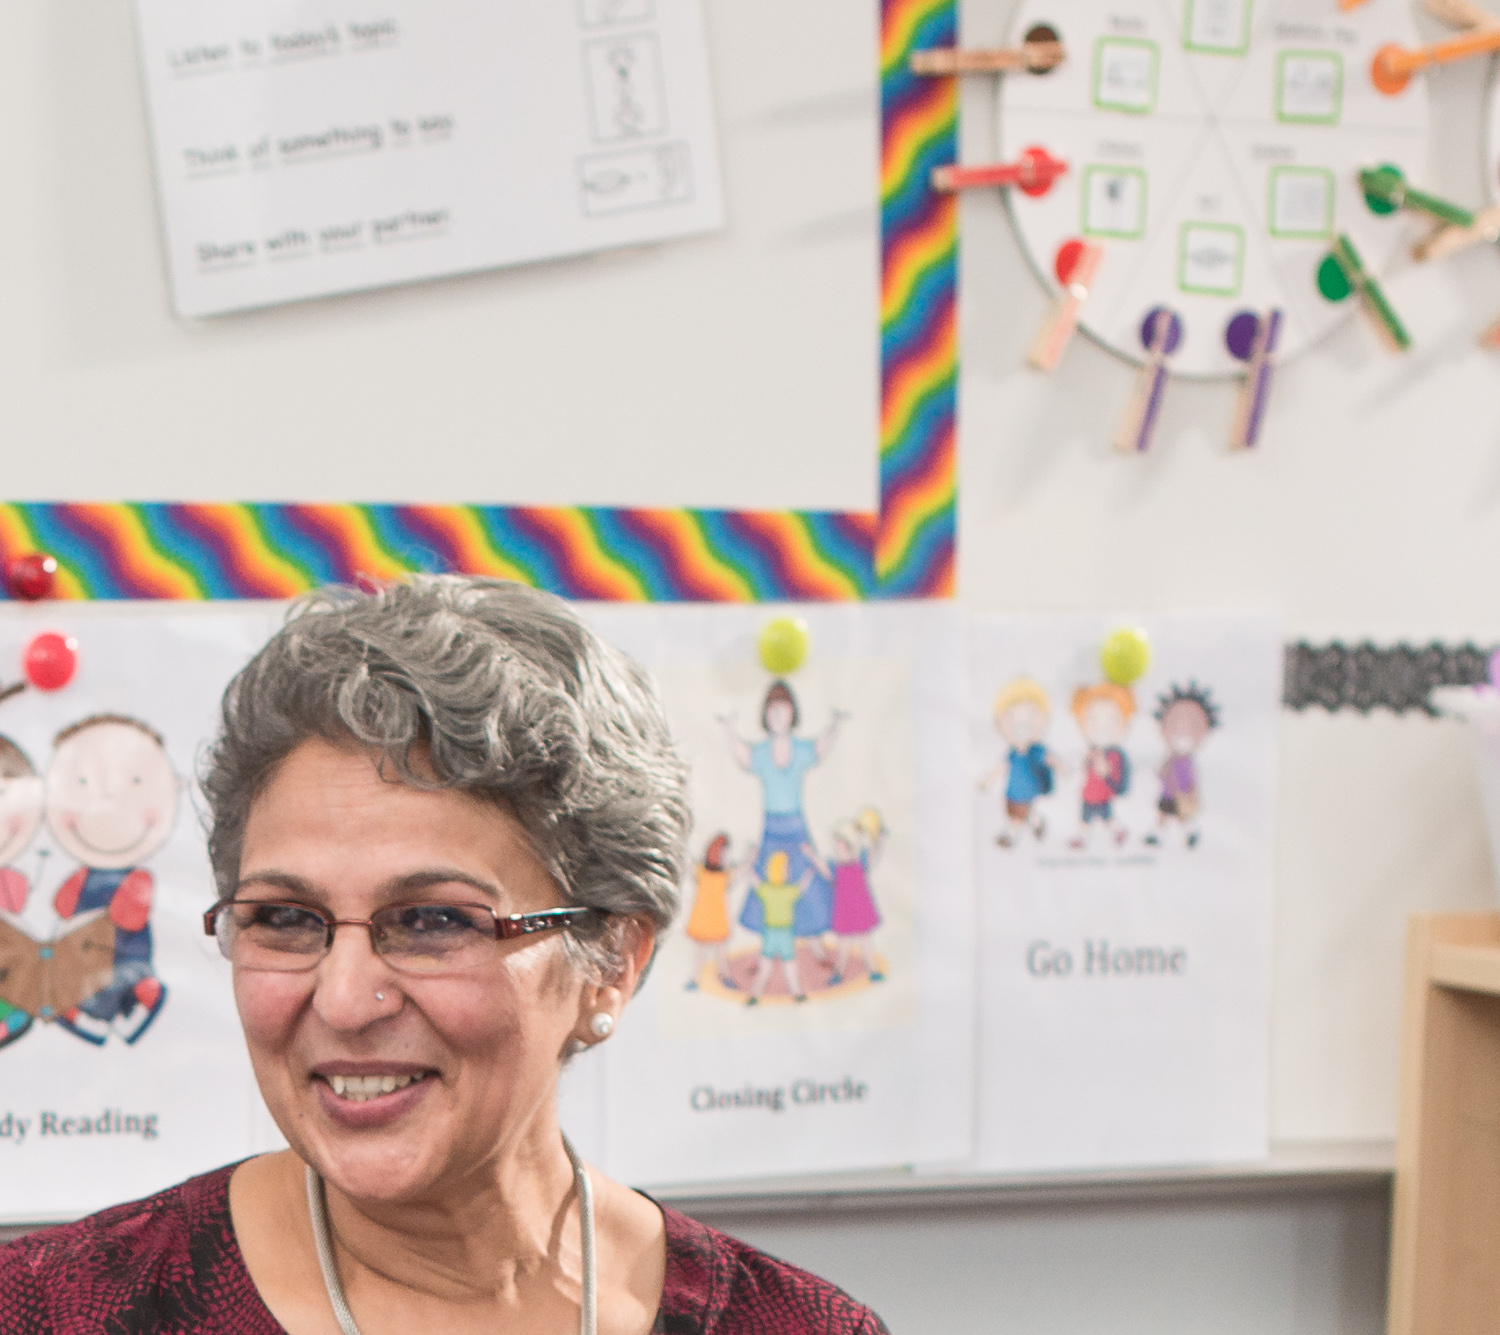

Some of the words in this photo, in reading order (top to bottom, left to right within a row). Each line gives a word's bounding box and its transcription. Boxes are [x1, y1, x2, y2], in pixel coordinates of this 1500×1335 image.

[1026, 940, 1072, 979] Go
[1084, 937, 1188, 977] Home
[690, 1082, 787, 1116] Closing
[790, 1076, 869, 1107] Circle
[39, 1108, 160, 1140] Reading
